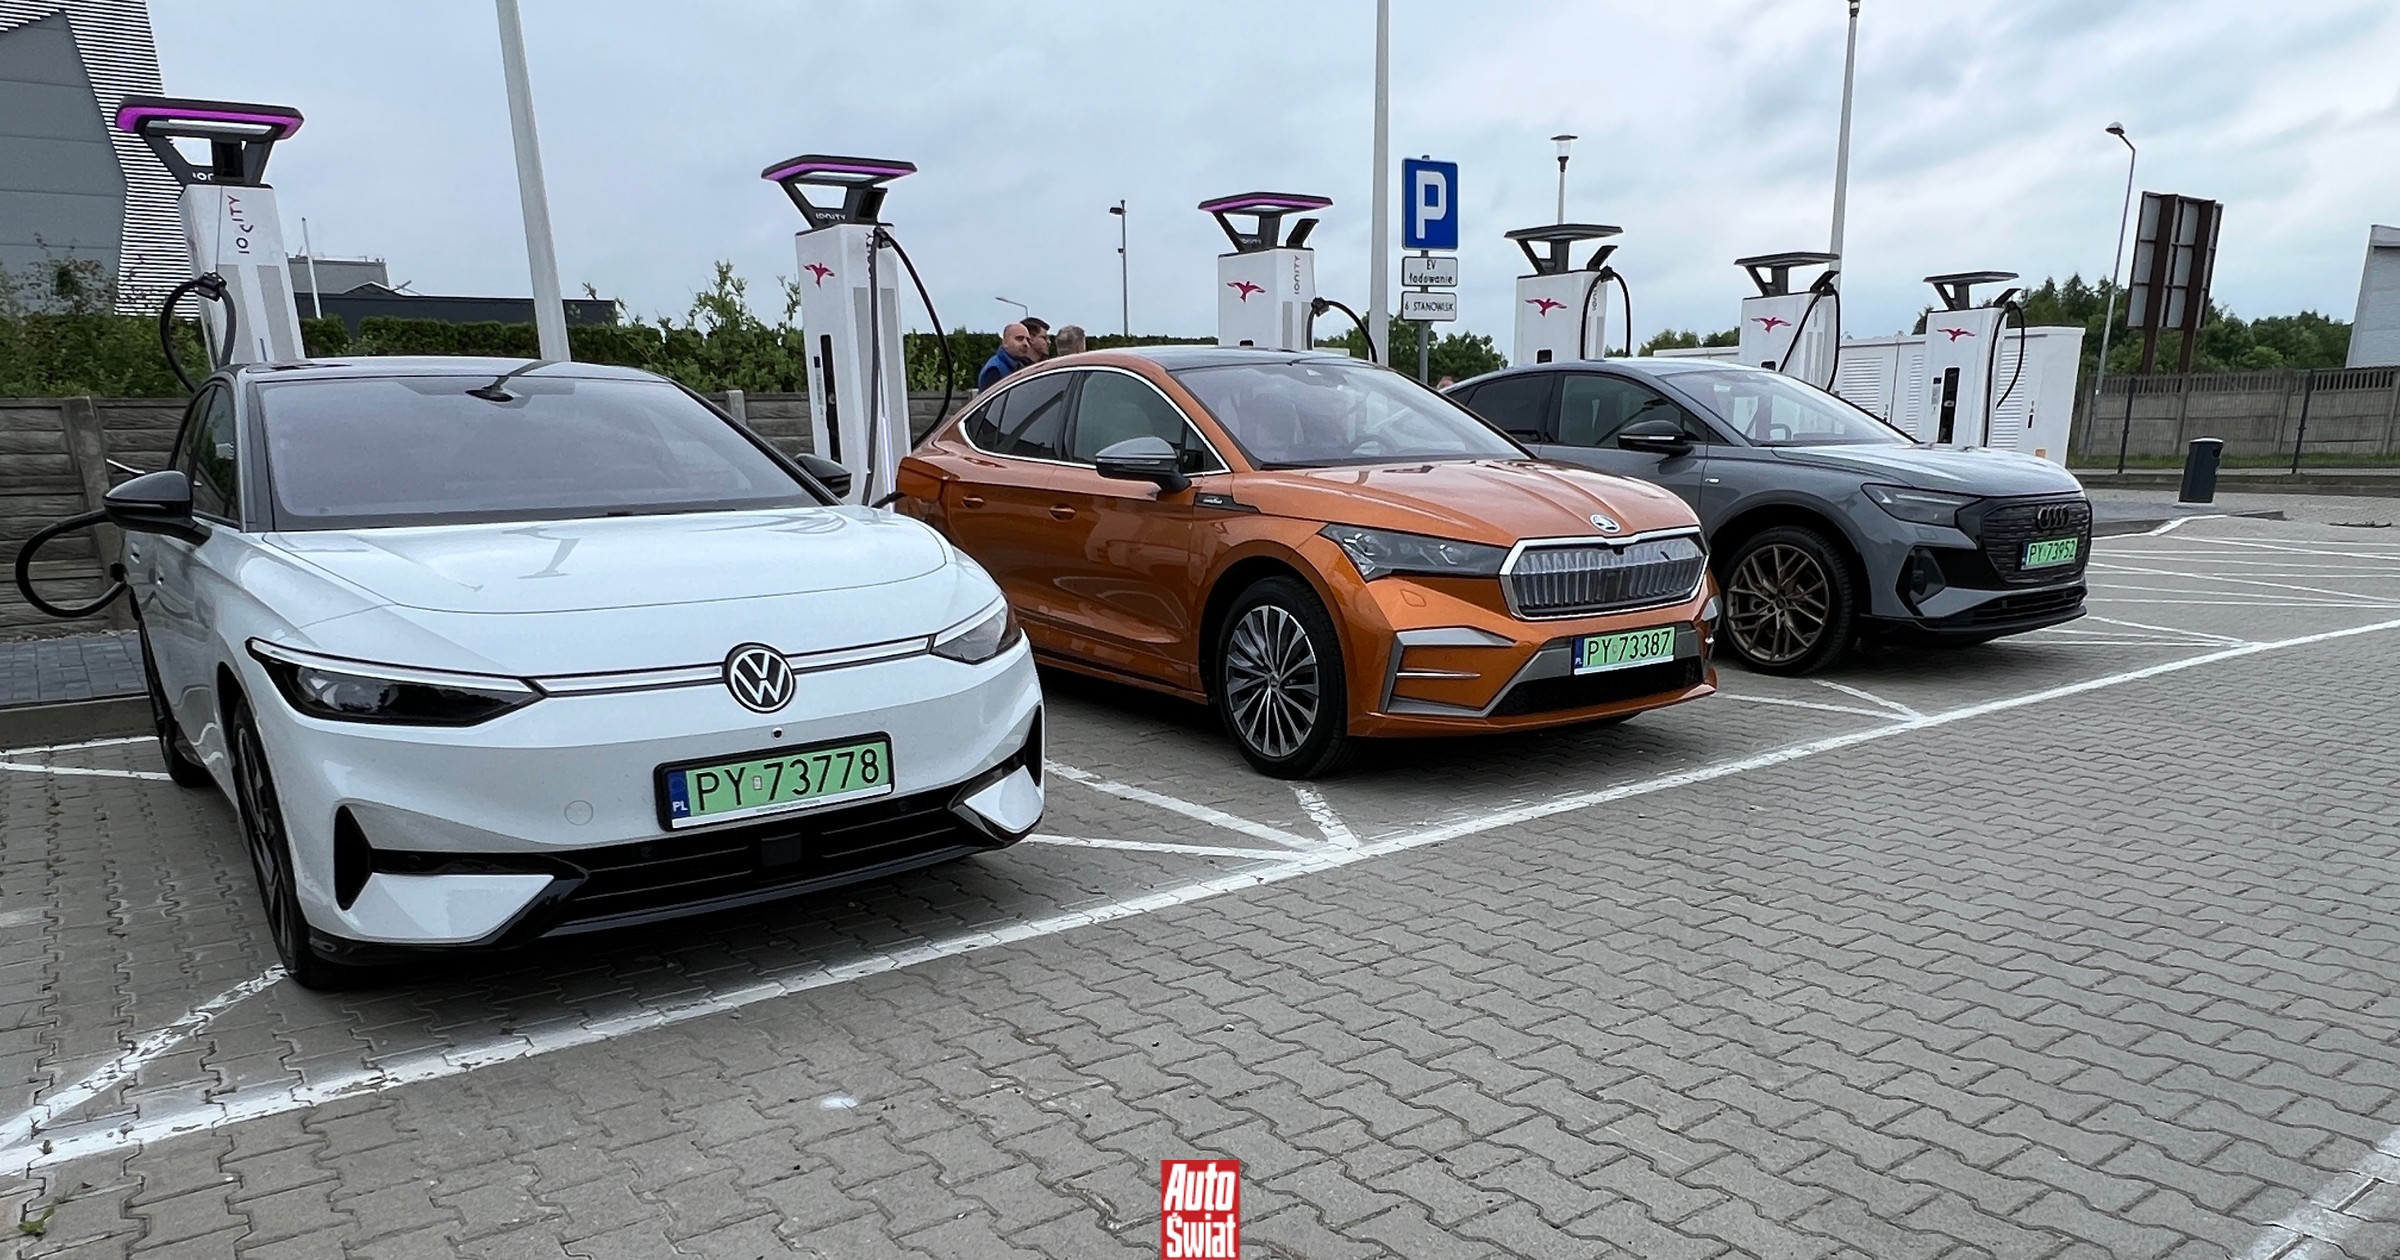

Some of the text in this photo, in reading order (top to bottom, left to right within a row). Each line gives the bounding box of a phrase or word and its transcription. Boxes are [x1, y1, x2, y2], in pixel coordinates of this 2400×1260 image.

[1416, 170, 1447, 239] P
[1426, 259, 1437, 270] EV
[1404, 301, 1410, 311] 6
[2028, 543, 2044, 564] PY
[2045, 539, 2076, 562] 73952
[1587, 630, 1671, 666] PY 73387
[696, 748, 879, 811] PY 73778
[672, 801, 688, 812] PL
